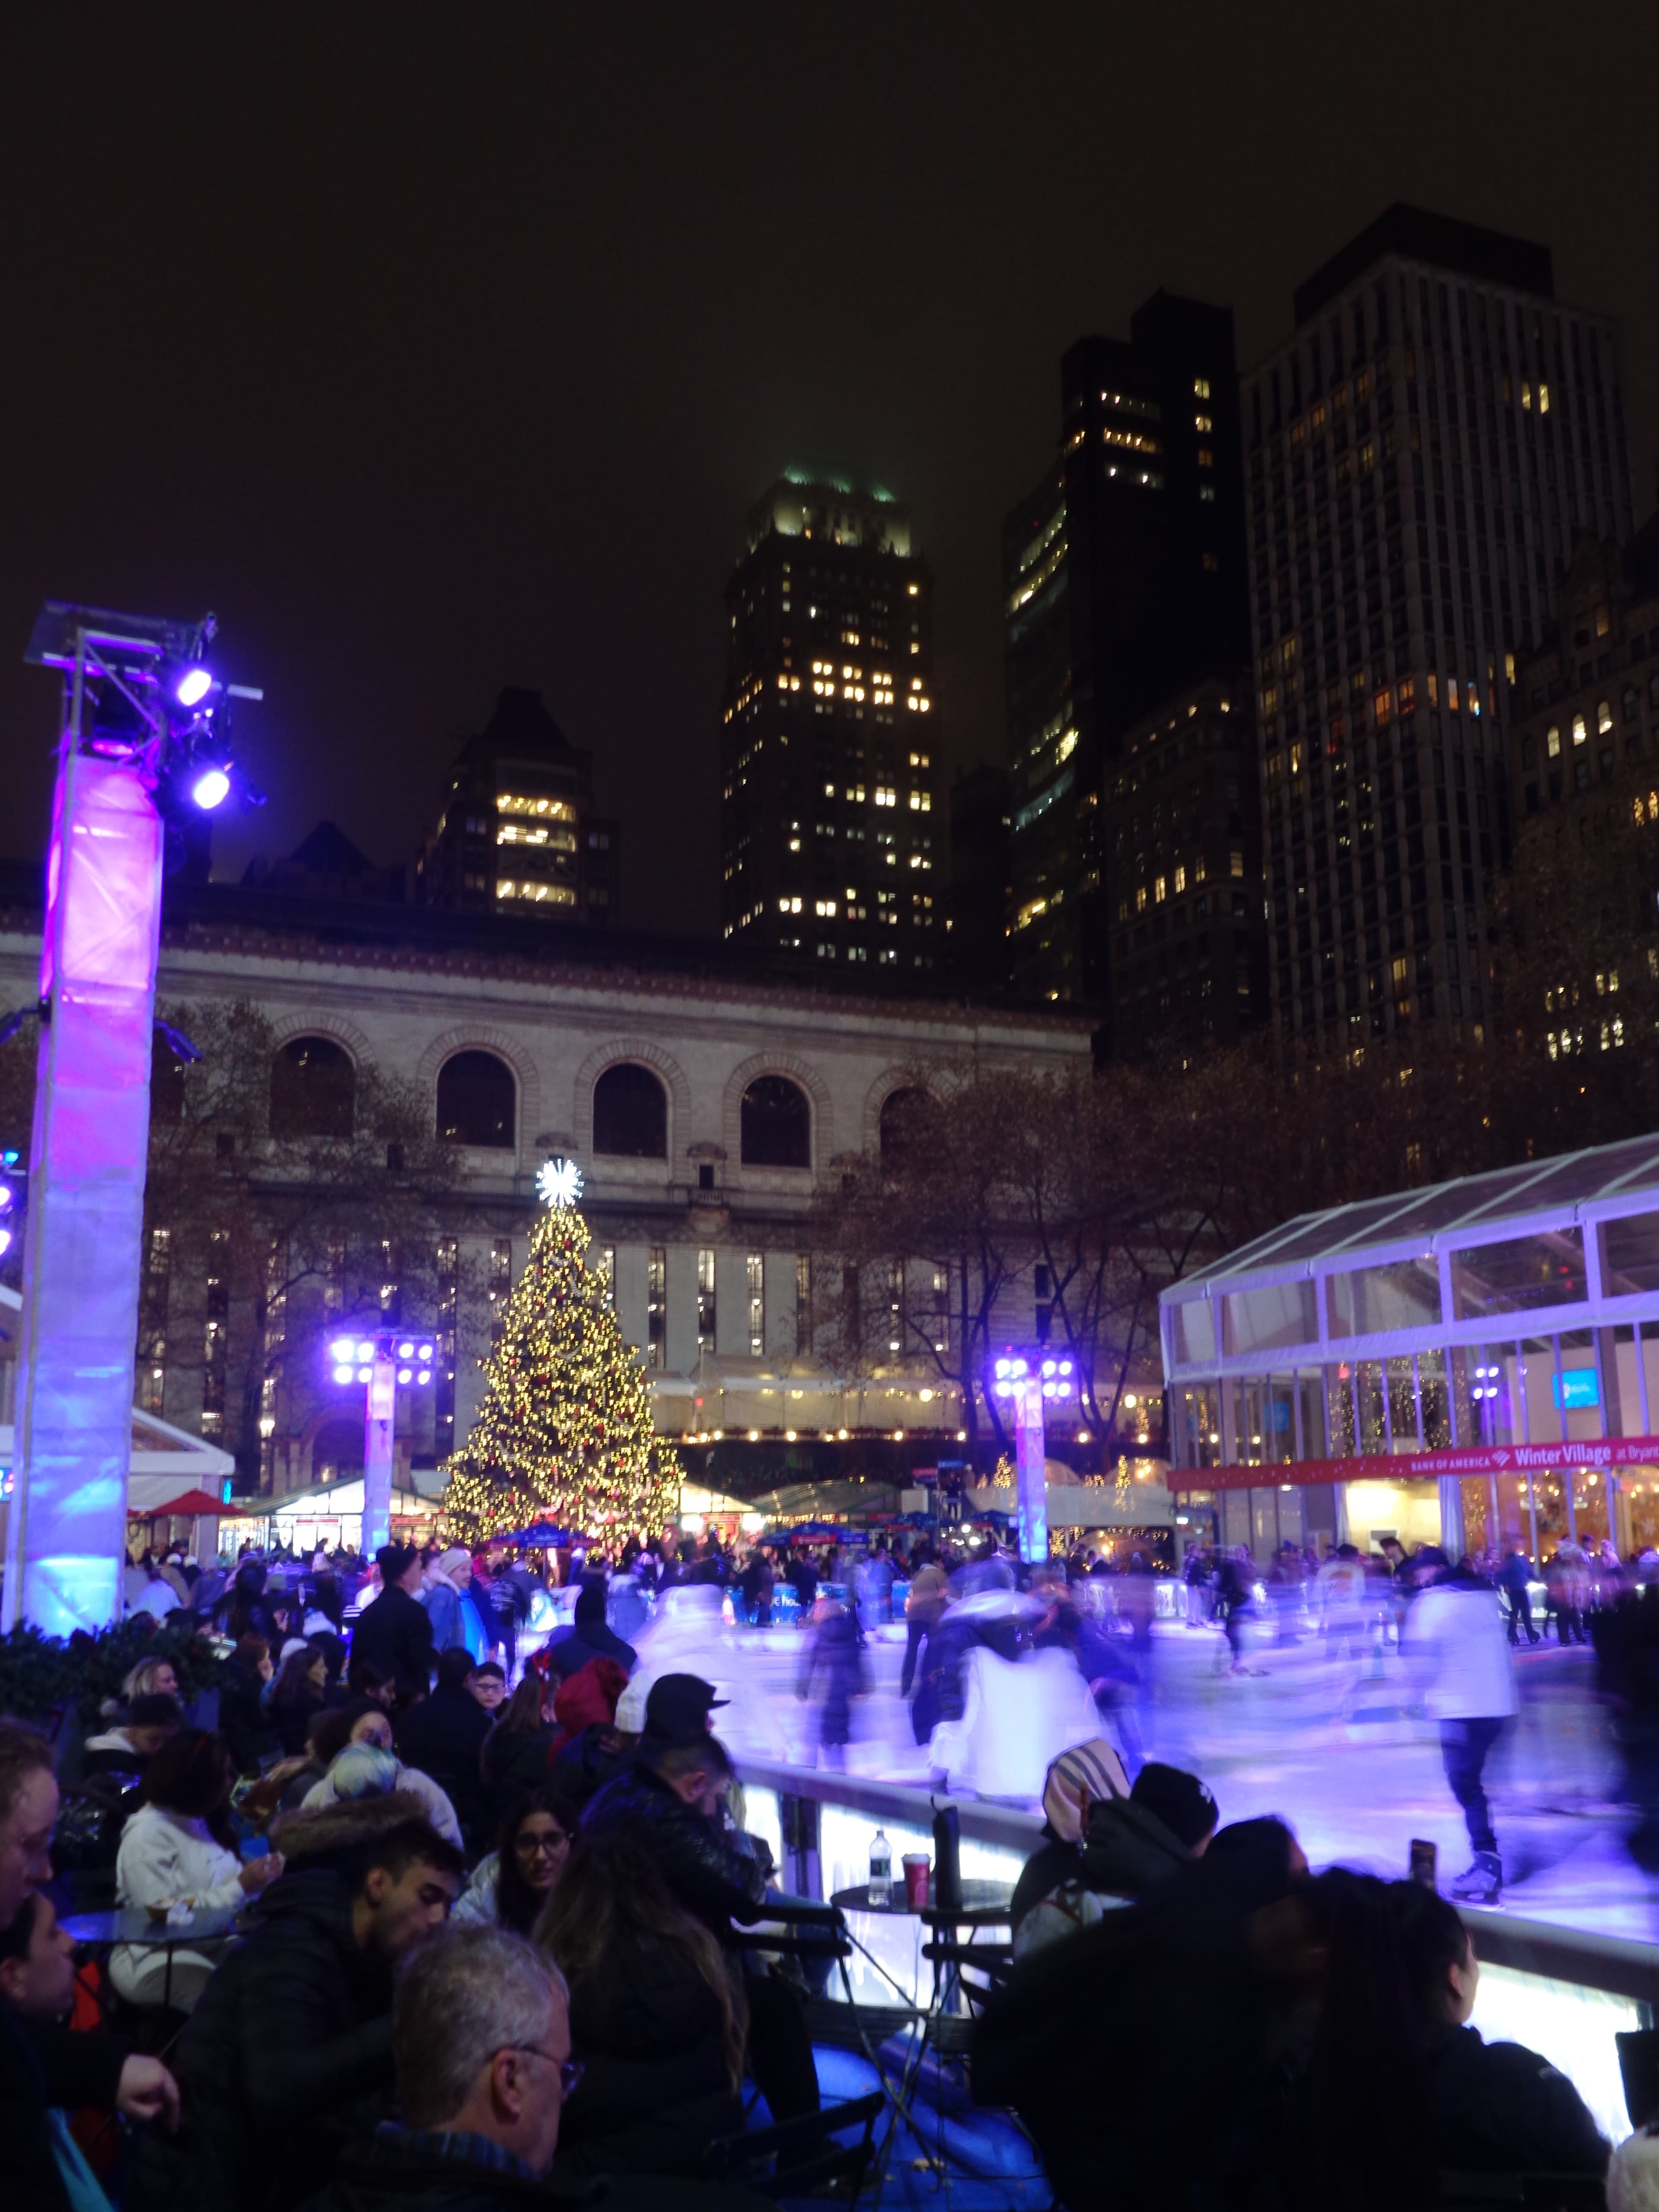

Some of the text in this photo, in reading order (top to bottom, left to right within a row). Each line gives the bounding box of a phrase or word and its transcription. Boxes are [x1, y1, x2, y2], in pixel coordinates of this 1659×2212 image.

[1411, 1461, 1435, 1472] BANK
[1436, 1459, 1447, 1470] OF
[1449, 1456, 1490, 1469] AMERICA
[1515, 1448, 1561, 1466] Winter
[1562, 1443, 1611, 1466] Village
[1617, 1448, 1626, 1460] at
